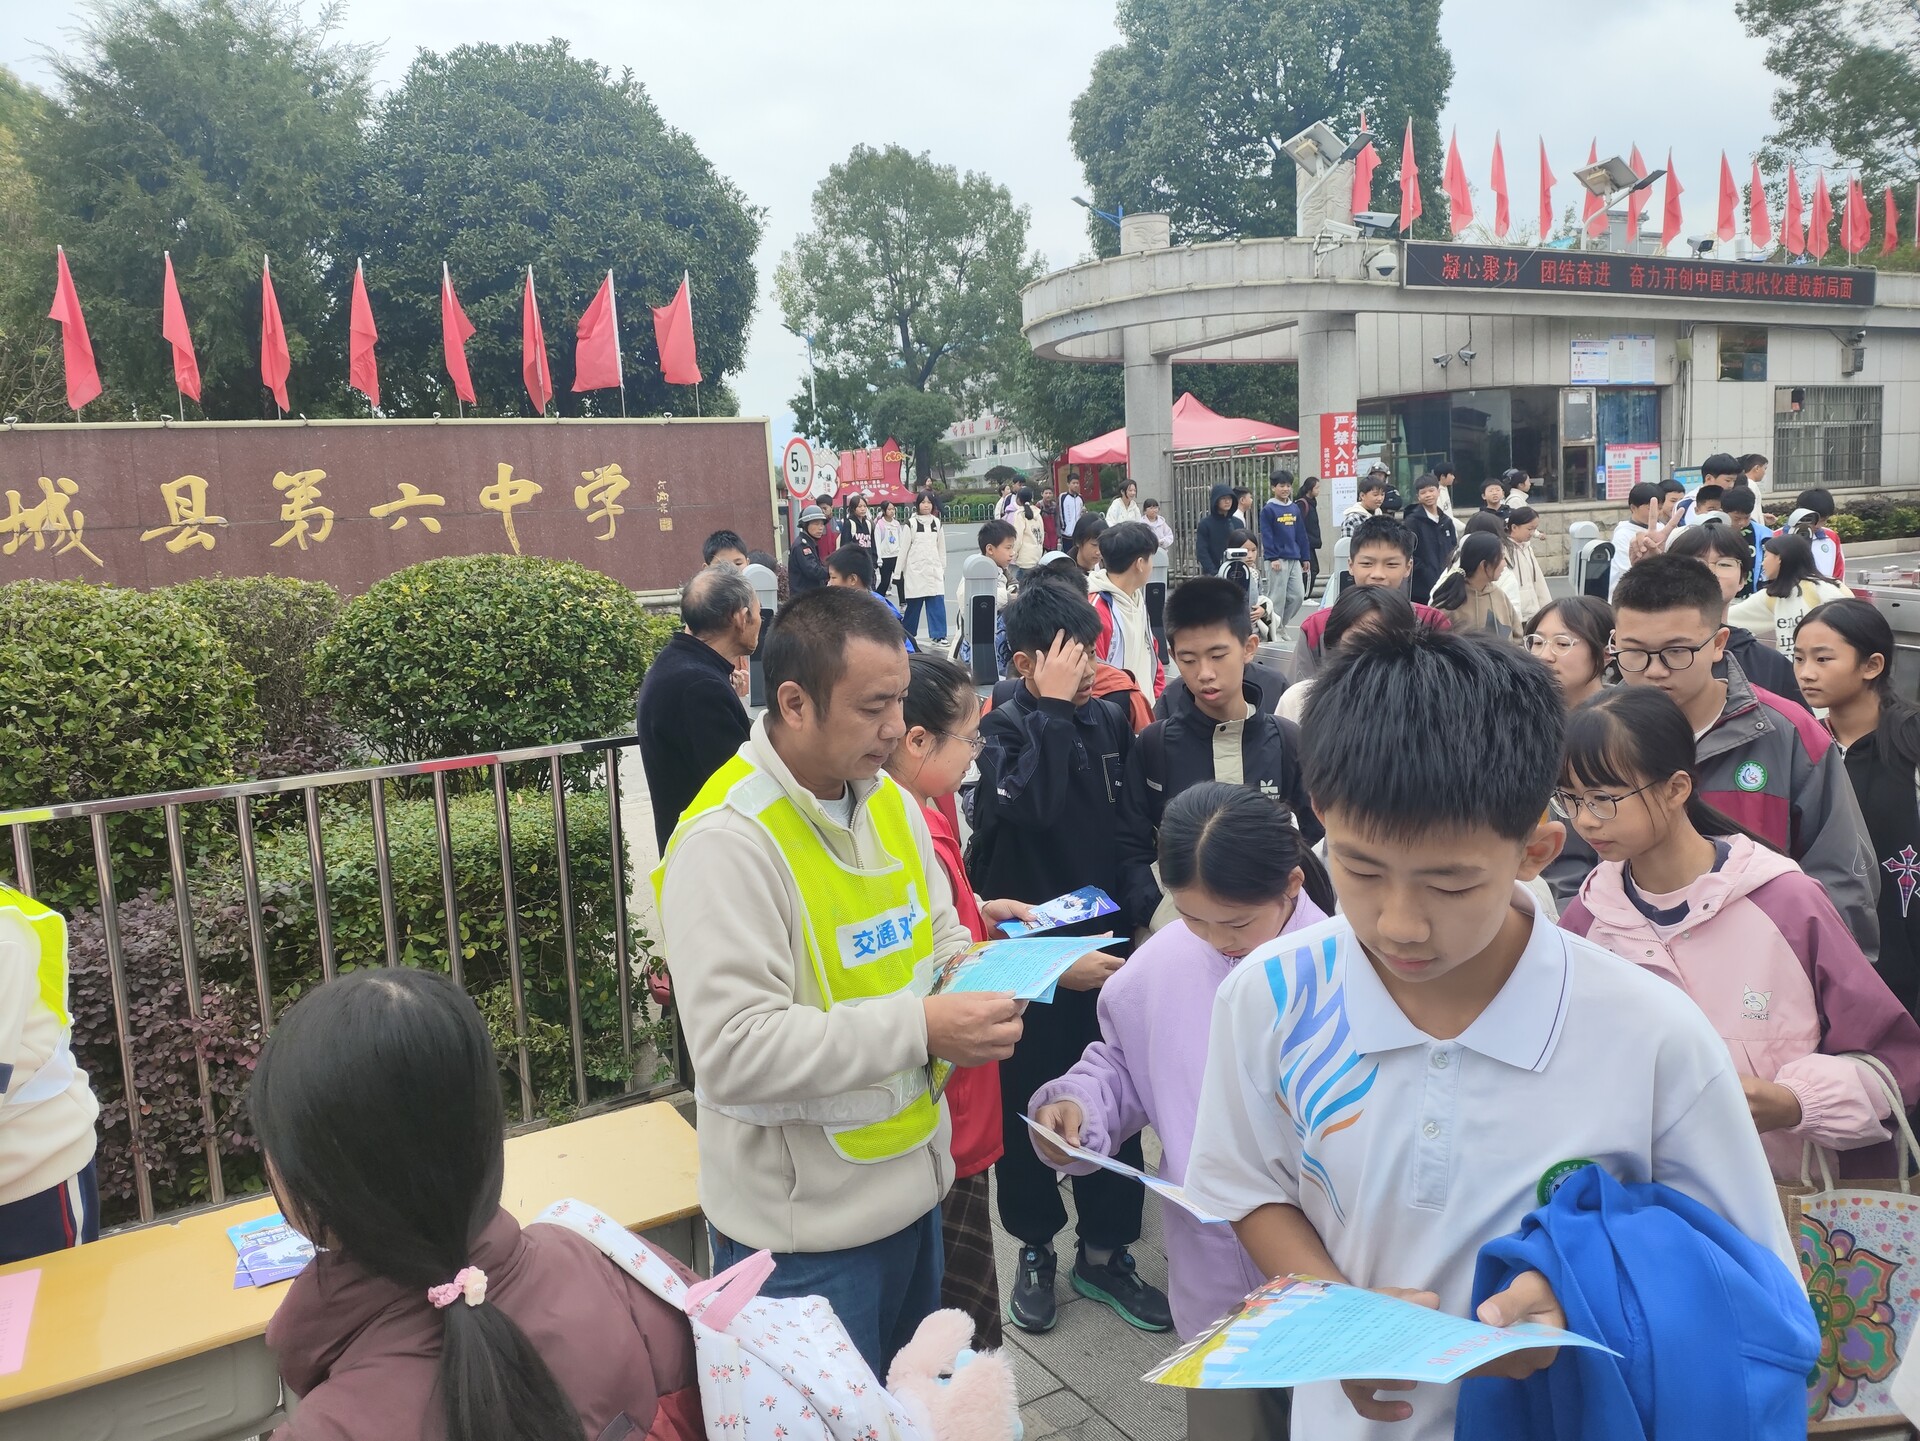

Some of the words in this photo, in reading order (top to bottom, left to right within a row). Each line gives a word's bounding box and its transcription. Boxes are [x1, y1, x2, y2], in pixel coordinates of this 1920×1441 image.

[1442, 253, 1518, 282] 凝心聚力
[1540, 259, 1611, 286] 团结奋进
[1630, 263, 1853, 298] 奋力开创中国式现代化建设新局面
[1333, 415, 1350, 476] 严禁入内
